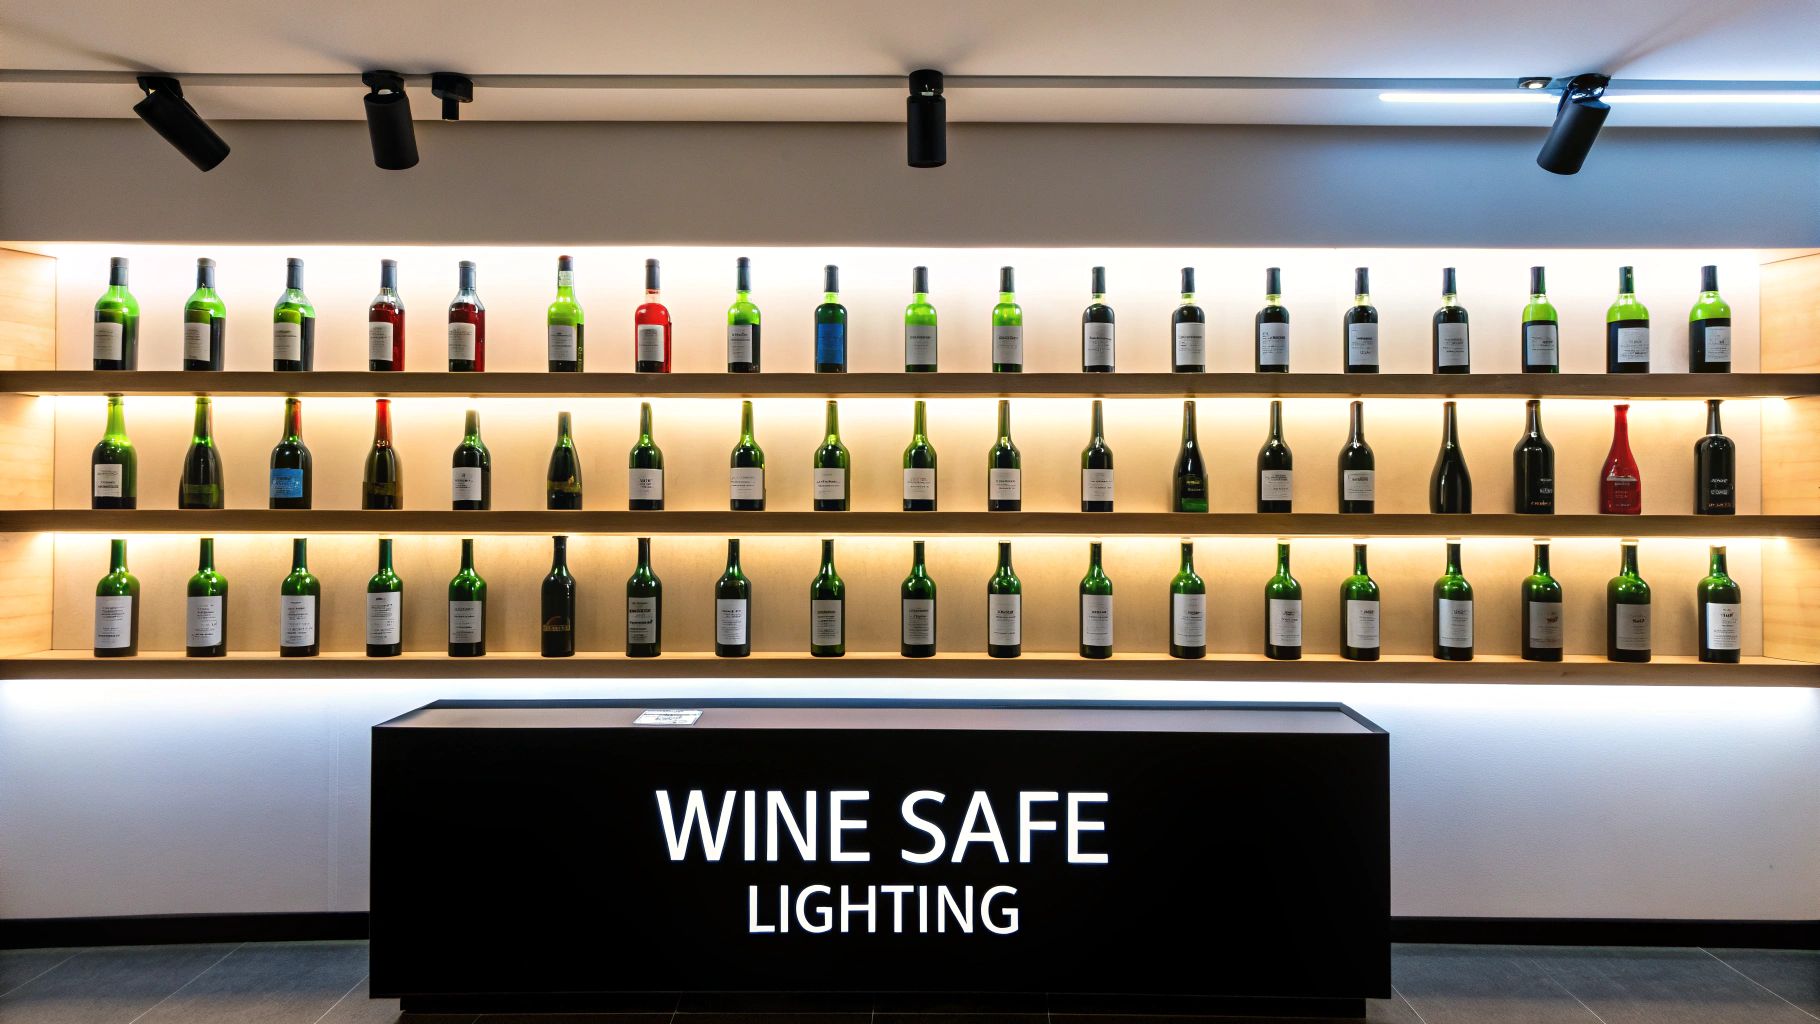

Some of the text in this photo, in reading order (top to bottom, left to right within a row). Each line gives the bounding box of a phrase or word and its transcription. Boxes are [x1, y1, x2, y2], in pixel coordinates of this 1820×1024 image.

[655, 789, 1110, 865] WINE SAFE
[748, 884, 1019, 935] LIGHTING
